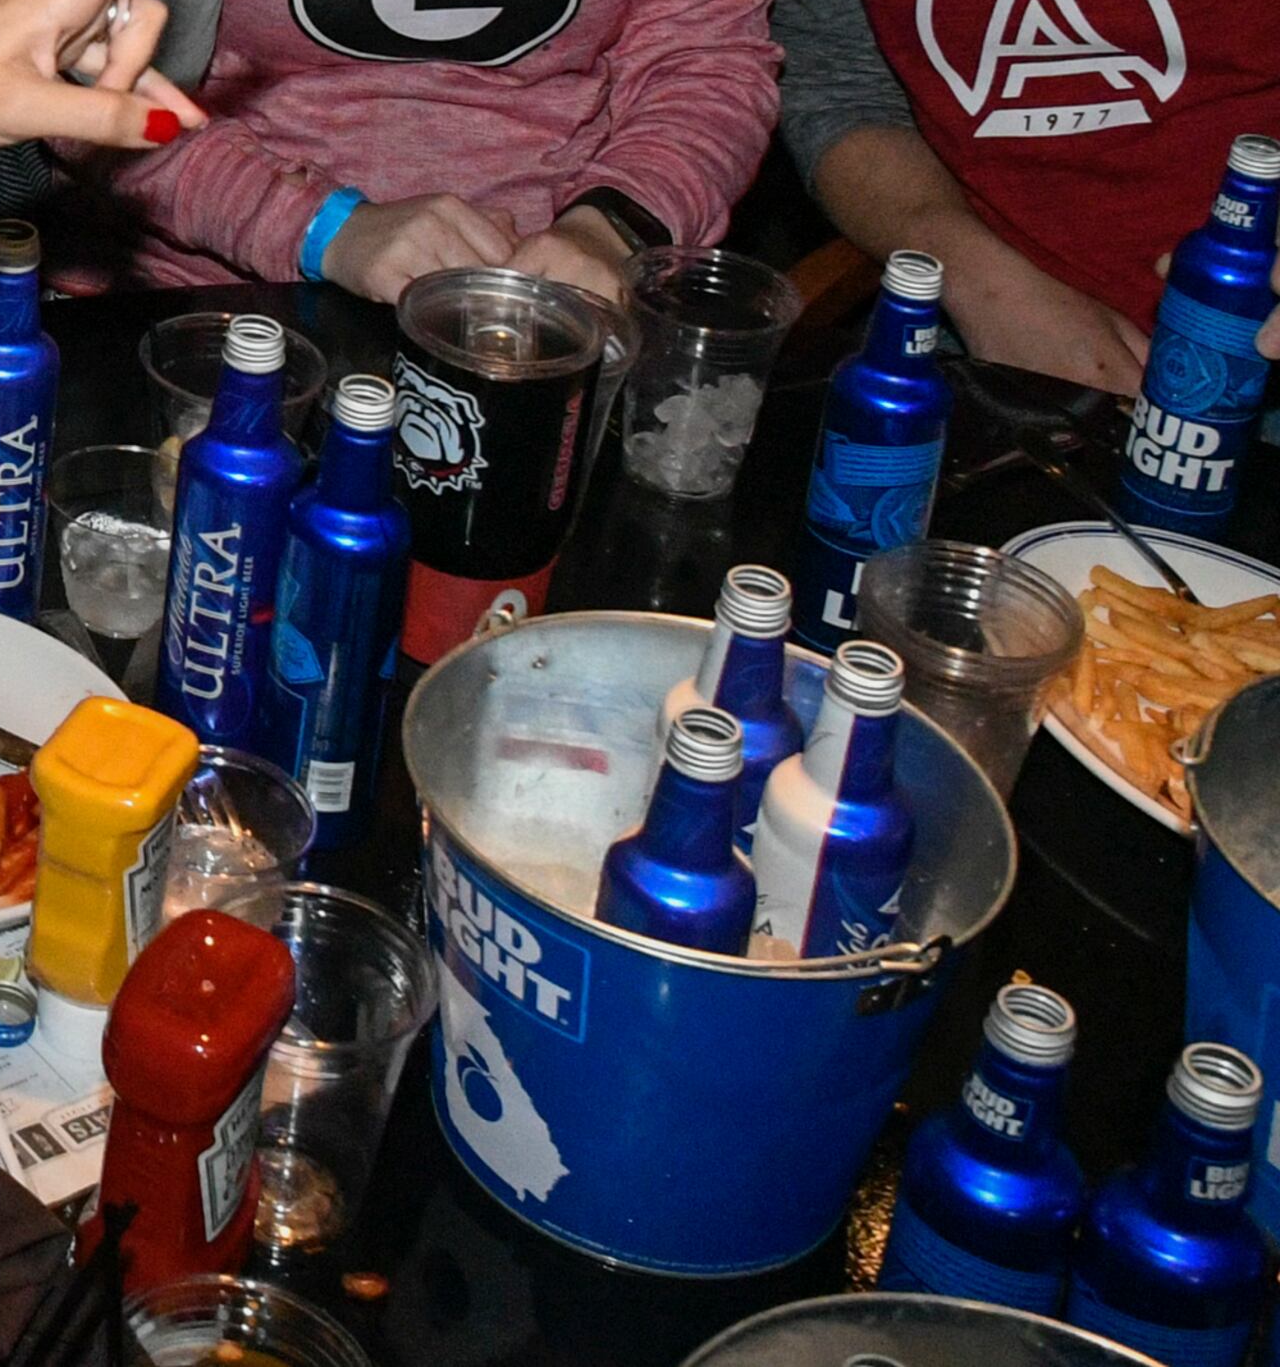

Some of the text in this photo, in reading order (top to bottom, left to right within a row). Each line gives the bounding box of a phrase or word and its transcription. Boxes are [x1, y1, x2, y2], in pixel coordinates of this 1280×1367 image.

[1023, 108, 1111, 132] 1977
[1125, 424, 1235, 492] IGHT
[1132, 392, 1220, 457] BUD
[181, 522, 243, 700] ULTRA
[231, 556, 255, 676] SUPERIOR LIGHT BEER
[433, 839, 542, 965] BUD
[67, 1110, 110, 1140] ATS
